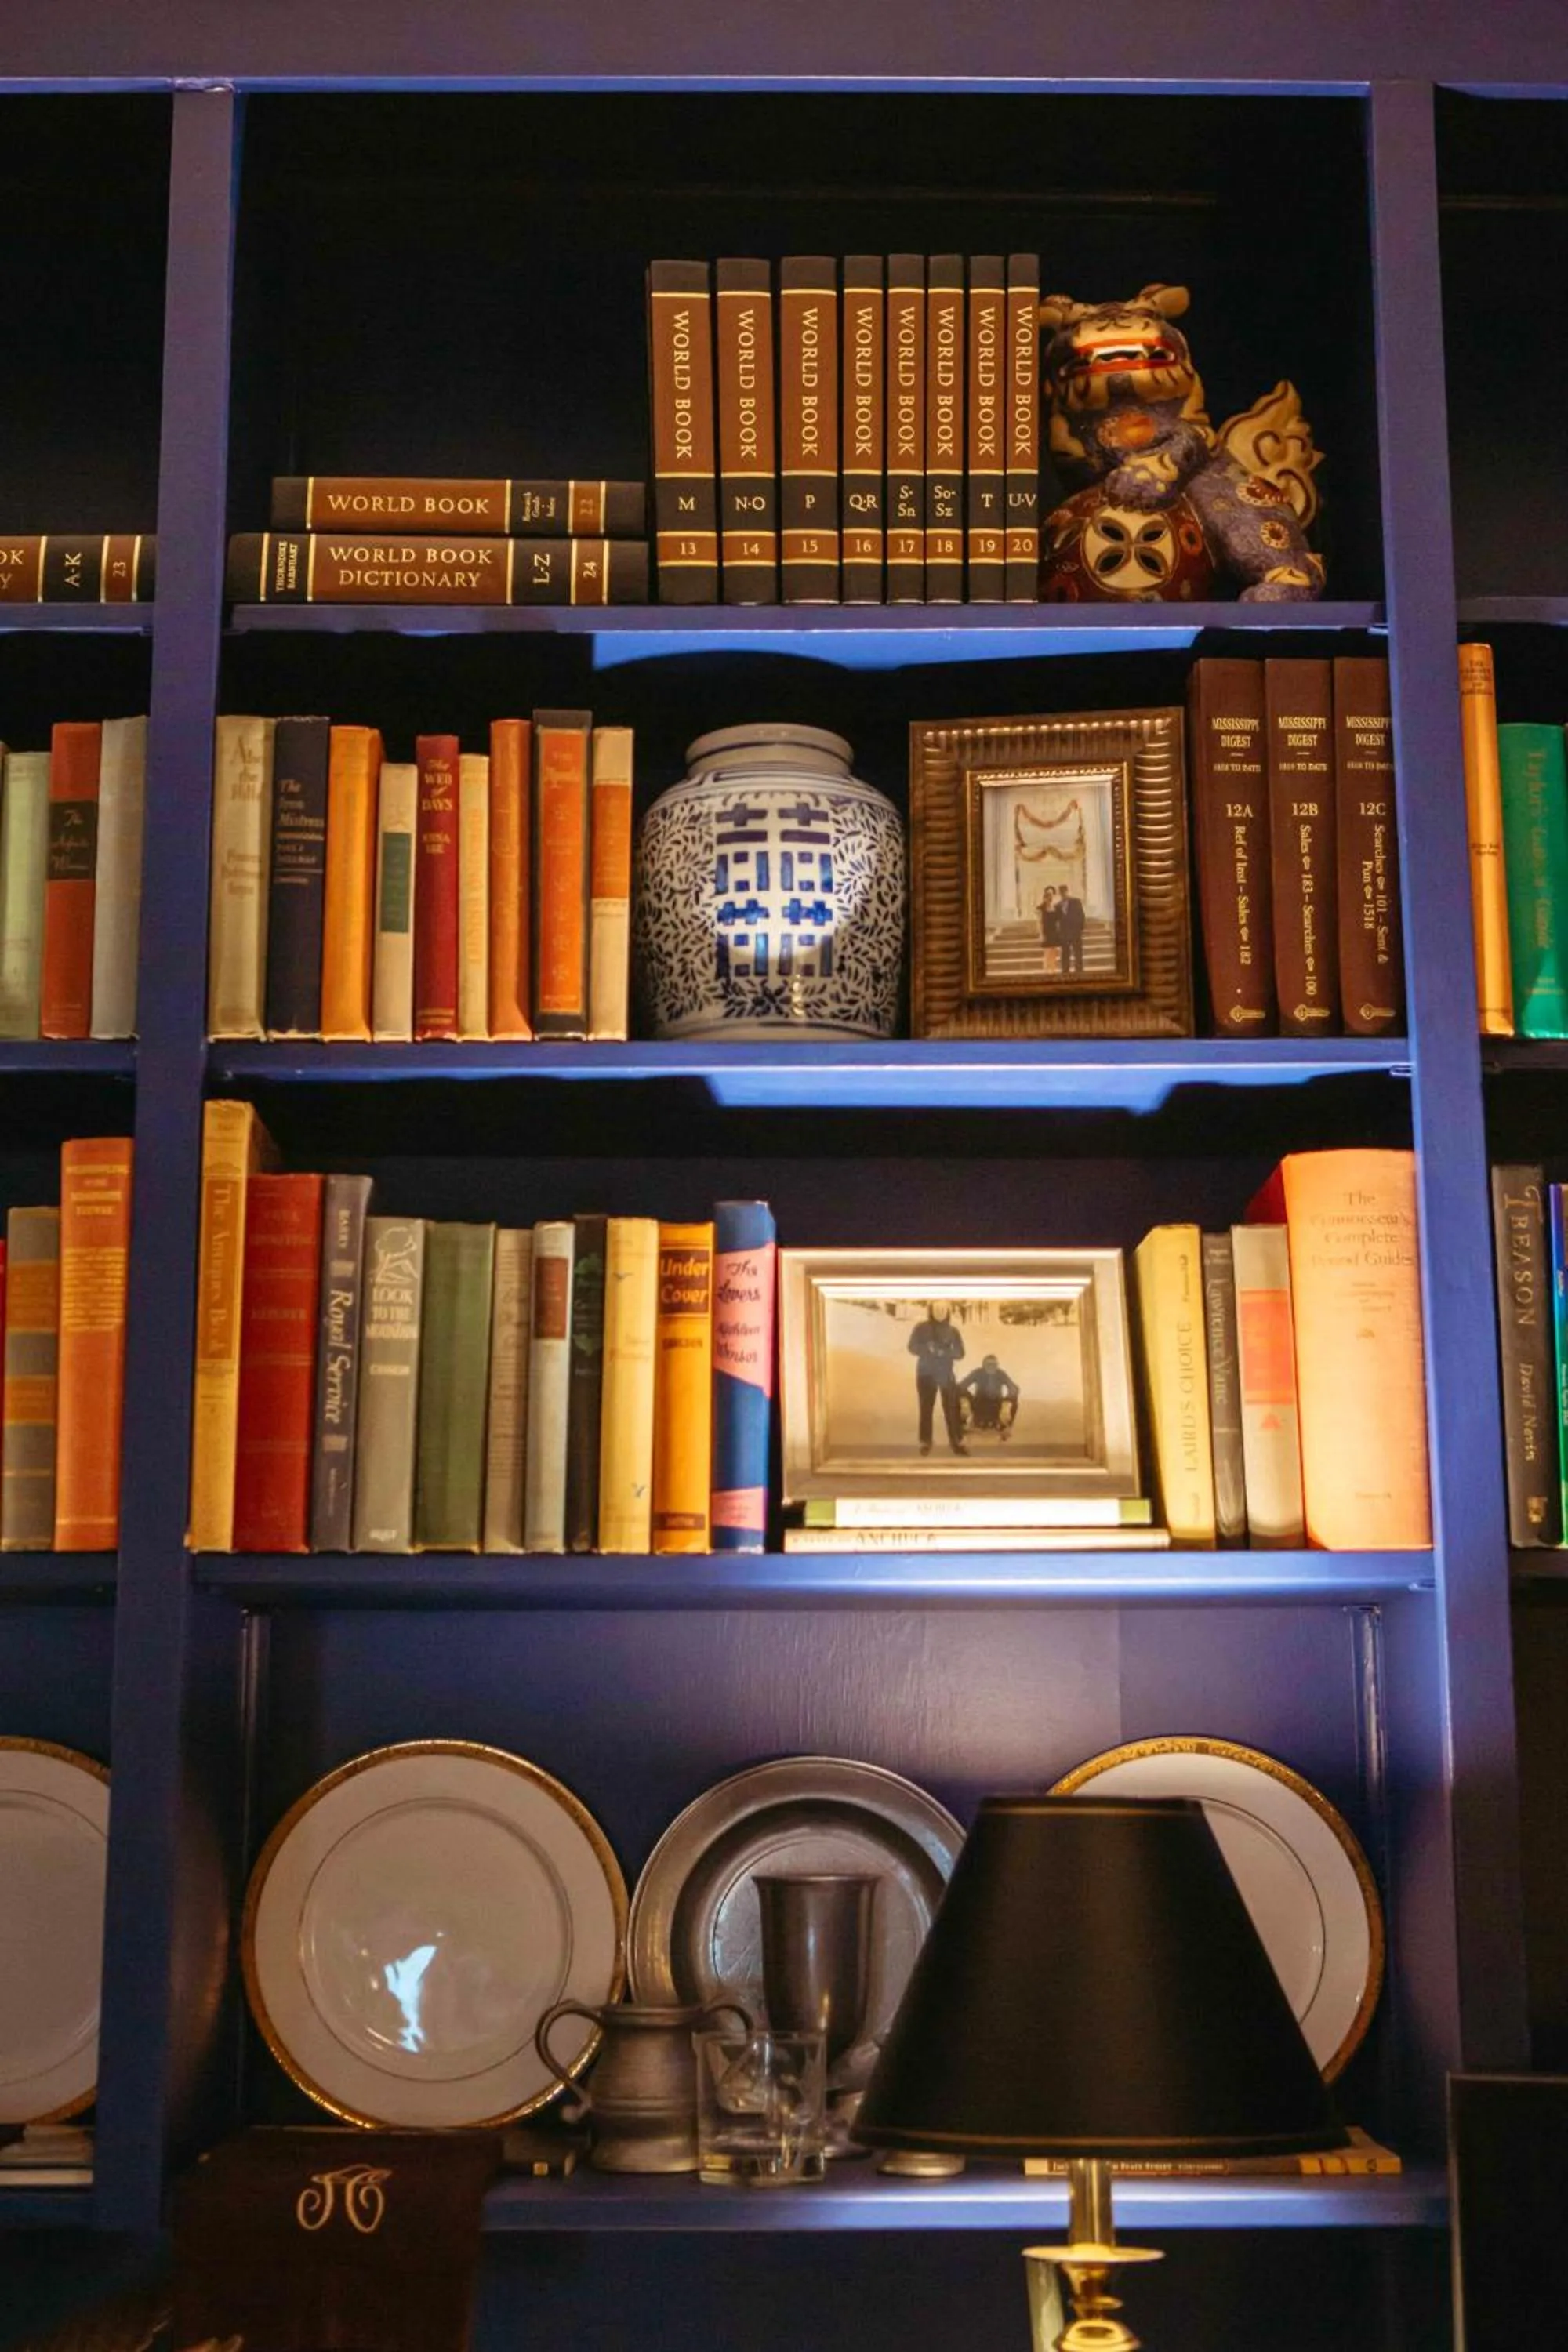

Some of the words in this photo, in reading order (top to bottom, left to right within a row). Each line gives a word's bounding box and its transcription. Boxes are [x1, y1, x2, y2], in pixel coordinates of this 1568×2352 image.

[673, 310, 691, 390] WORLD
[738, 309, 756, 390] WORLD
[801, 307, 818, 387] WORLD
[855, 307, 873, 387] WORLD
[898, 307, 916, 387] WORLD
[938, 307, 955, 387] WORLD
[978, 307, 996, 387] WORLD
[1015, 305, 1033, 387] WORLD
[675, 399, 693, 459] BOOK
[739, 398, 757, 459] BOOK
[802, 395, 818, 456] BOOK
[855, 395, 873, 456] BOOK
[898, 395, 915, 456] BOOK
[937, 394, 954, 456] BOOK
[978, 394, 996, 456] BOOK
[1015, 394, 1032, 456] BOOK
[327, 495, 416, 514] WORLD
[425, 496, 490, 514] BOOK
[678, 496, 695, 511] M
[806, 495, 815, 509] P
[898, 503, 916, 518] Sn
[935, 503, 953, 518] Sz
[982, 494, 993, 508] T
[330, 546, 416, 564] WORLD
[426, 548, 493, 565] BOOK
[681, 541, 697, 556] 13
[742, 542, 760, 556] 14
[801, 540, 818, 554] 15
[855, 539, 872, 554] 16
[899, 539, 915, 554] 17
[937, 539, 953, 554] 18
[979, 539, 996, 554] 19
[1013, 539, 1033, 554] 20
[112, 561, 127, 578] 23
[583, 561, 597, 579] 24
[339, 569, 482, 590] DICTIONARY
[1212, 717, 1260, 732] MISSISSIPPI
[1278, 716, 1327, 731] MISSISSIPPI
[1221, 735, 1252, 748] DIGEST
[1287, 734, 1318, 746] DIGEST
[1356, 733, 1385, 746] DIGEST
[1225, 803, 1254, 818] 12A
[1291, 802, 1319, 817] 12B
[1359, 802, 1387, 816] 12C
[1300, 824, 1312, 854] Sales
[1374, 823, 1388, 874] Searches
[1236, 847, 1248, 860] of
[1361, 861, 1374, 884] Pun
[1238, 895, 1250, 925] Sales
[1302, 903, 1317, 956] Searches
[1305, 975, 1318, 996] 100
[1343, 1190, 1376, 1206] The
[660, 1257, 710, 1278] Under
[372, 1287, 414, 1305] LOOK
[660, 1285, 710, 1305] Cover
[327, 1288, 354, 1349] Royal
[1177, 1321, 1194, 1395] CHOICE
[323, 1355, 351, 1424] Service
